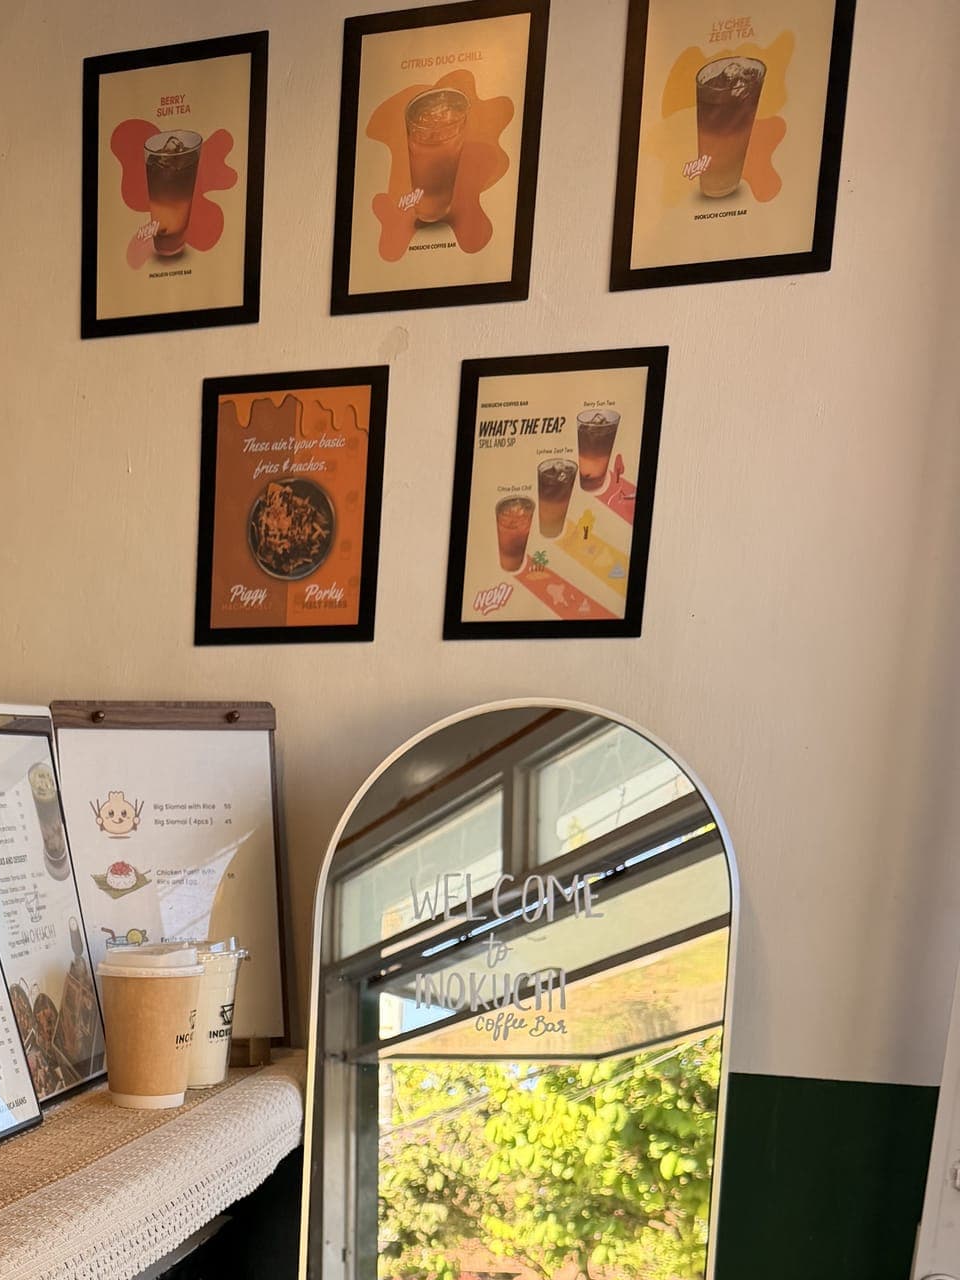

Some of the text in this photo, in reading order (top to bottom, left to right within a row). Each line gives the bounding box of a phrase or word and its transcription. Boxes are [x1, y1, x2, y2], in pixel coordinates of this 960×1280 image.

[712, 16, 752, 32] LYCHEE
[736, 28, 755, 39] TEA
[400, 51, 483, 70] CITRUS DUO CHILL
[160, 94, 186, 106] BERRY
[156, 105, 191, 118] SUN TEA
[479, 416, 566, 438] WHAT'S THE TEA?
[243, 436, 271, 452] These
[294, 439, 318, 454] your
[319, 433, 345, 449] basic
[479, 437, 516, 449] SPILL AND SIP
[253, 456, 327, 479] fries & nachos.
[230, 581, 344, 605] Piggy Porky
[153, 803, 164, 812] Big
[154, 818, 165, 827] Big
[410, 872, 604, 923] WELCOME
[482, 932, 513, 968] to
[415, 967, 567, 1013] INOKUCHI
[529, 1014, 568, 1037] Bar
